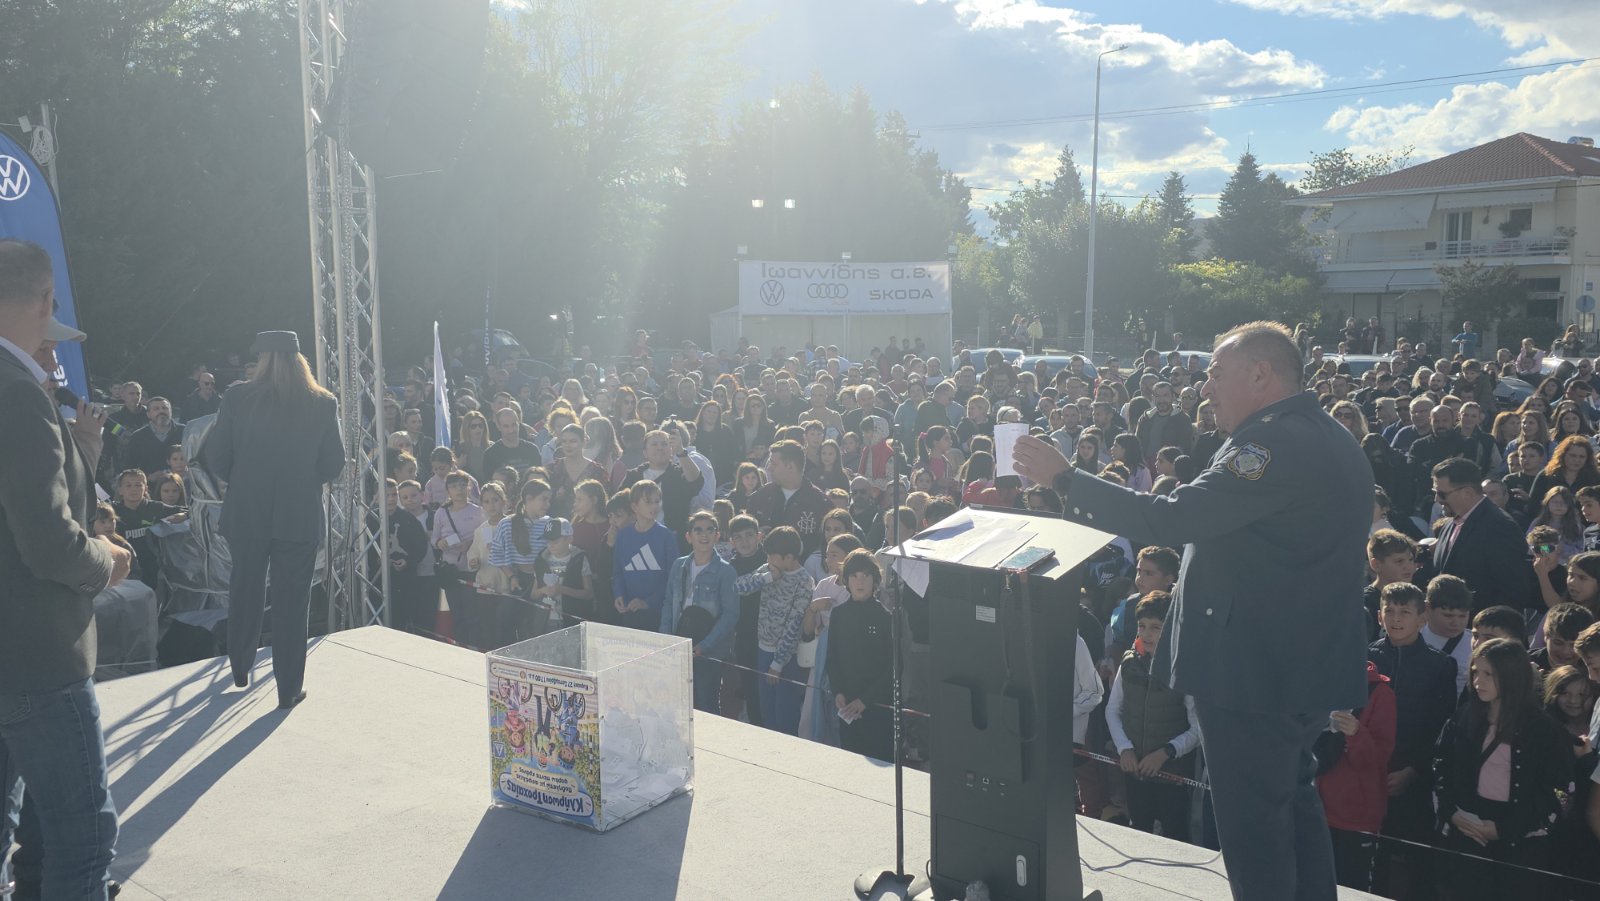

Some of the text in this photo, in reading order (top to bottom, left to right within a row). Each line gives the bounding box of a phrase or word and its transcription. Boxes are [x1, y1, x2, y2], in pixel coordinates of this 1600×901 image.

[125, 528, 147, 540] PUM
[506, 778, 584, 813] Κλήρωση Τροχαίας
